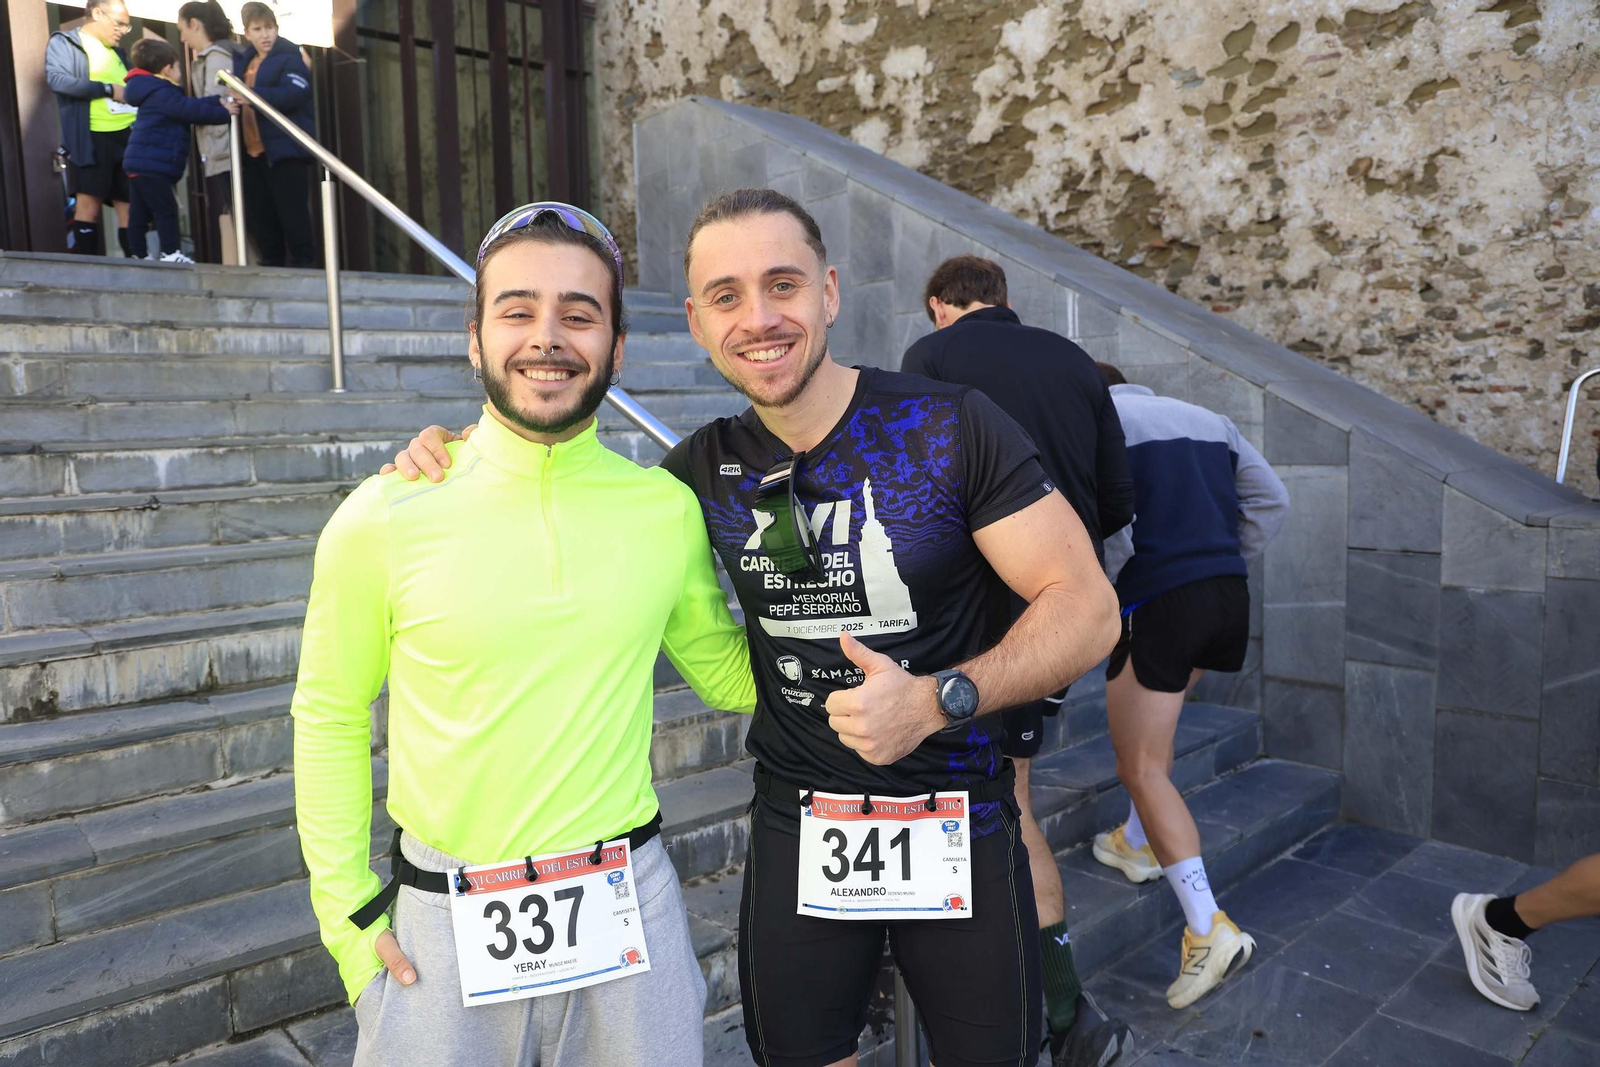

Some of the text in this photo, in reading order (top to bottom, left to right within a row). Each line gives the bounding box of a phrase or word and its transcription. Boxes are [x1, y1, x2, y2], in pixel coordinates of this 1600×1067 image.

[821, 551, 854, 569] DEL
[792, 592, 860, 603] MEMORIAL
[769, 603, 862, 616] PEPE SERRANO
[793, 624, 838, 634] DICIEMBRE
[841, 622, 864, 632] 2025
[878, 619, 910, 628] TARIFA
[880, 805, 899, 814] DEL
[822, 827, 911, 882] 341
[542, 862, 564, 875] DEL
[952, 866, 958, 874] S
[830, 887, 886, 897] ALEXANDRO
[612, 907, 636, 917] CAMISETA
[483, 885, 584, 960] 337
[623, 917, 629, 926] S
[514, 960, 547, 974] YERAY
